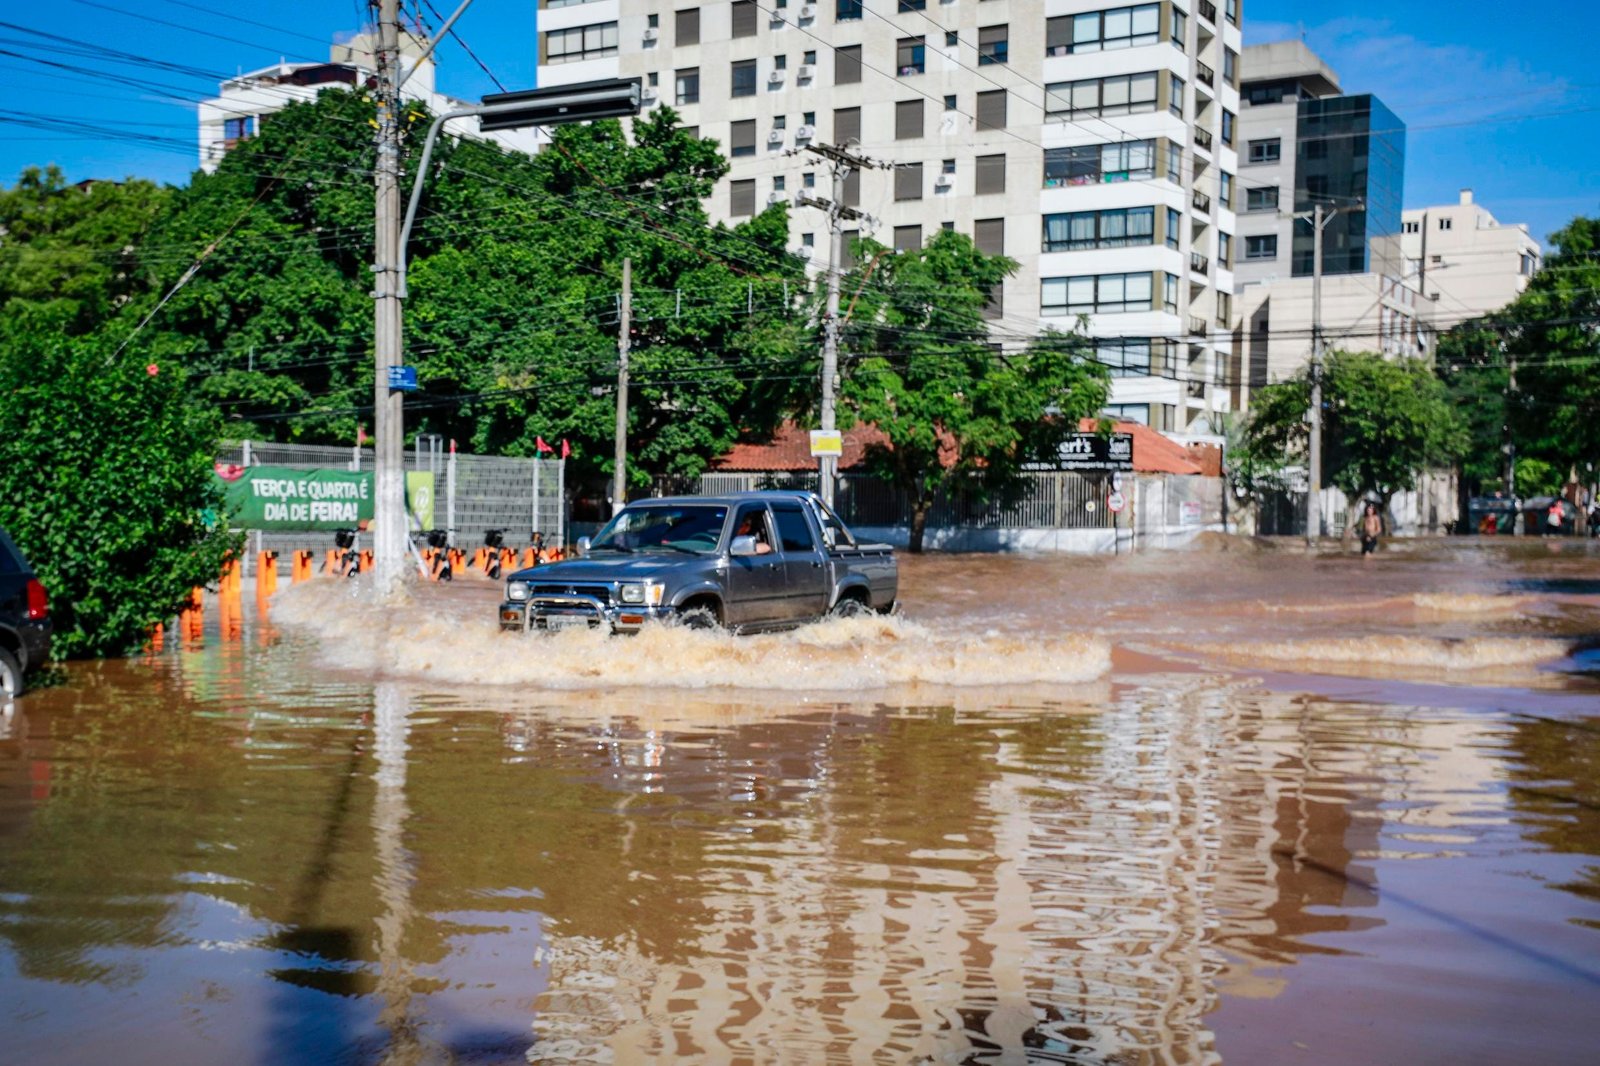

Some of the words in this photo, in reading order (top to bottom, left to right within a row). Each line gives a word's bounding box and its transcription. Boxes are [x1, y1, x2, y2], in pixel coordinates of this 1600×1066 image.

[1056, 437, 1092, 453] ert's
[251, 479, 297, 501] TERÇA
[298, 481, 308, 498] E
[308, 481, 359, 500] QUARTA
[360, 479, 368, 499] É
[264, 503, 288, 521] DIA
[290, 504, 309, 521] DE
[310, 502, 358, 521] FEIRA!
